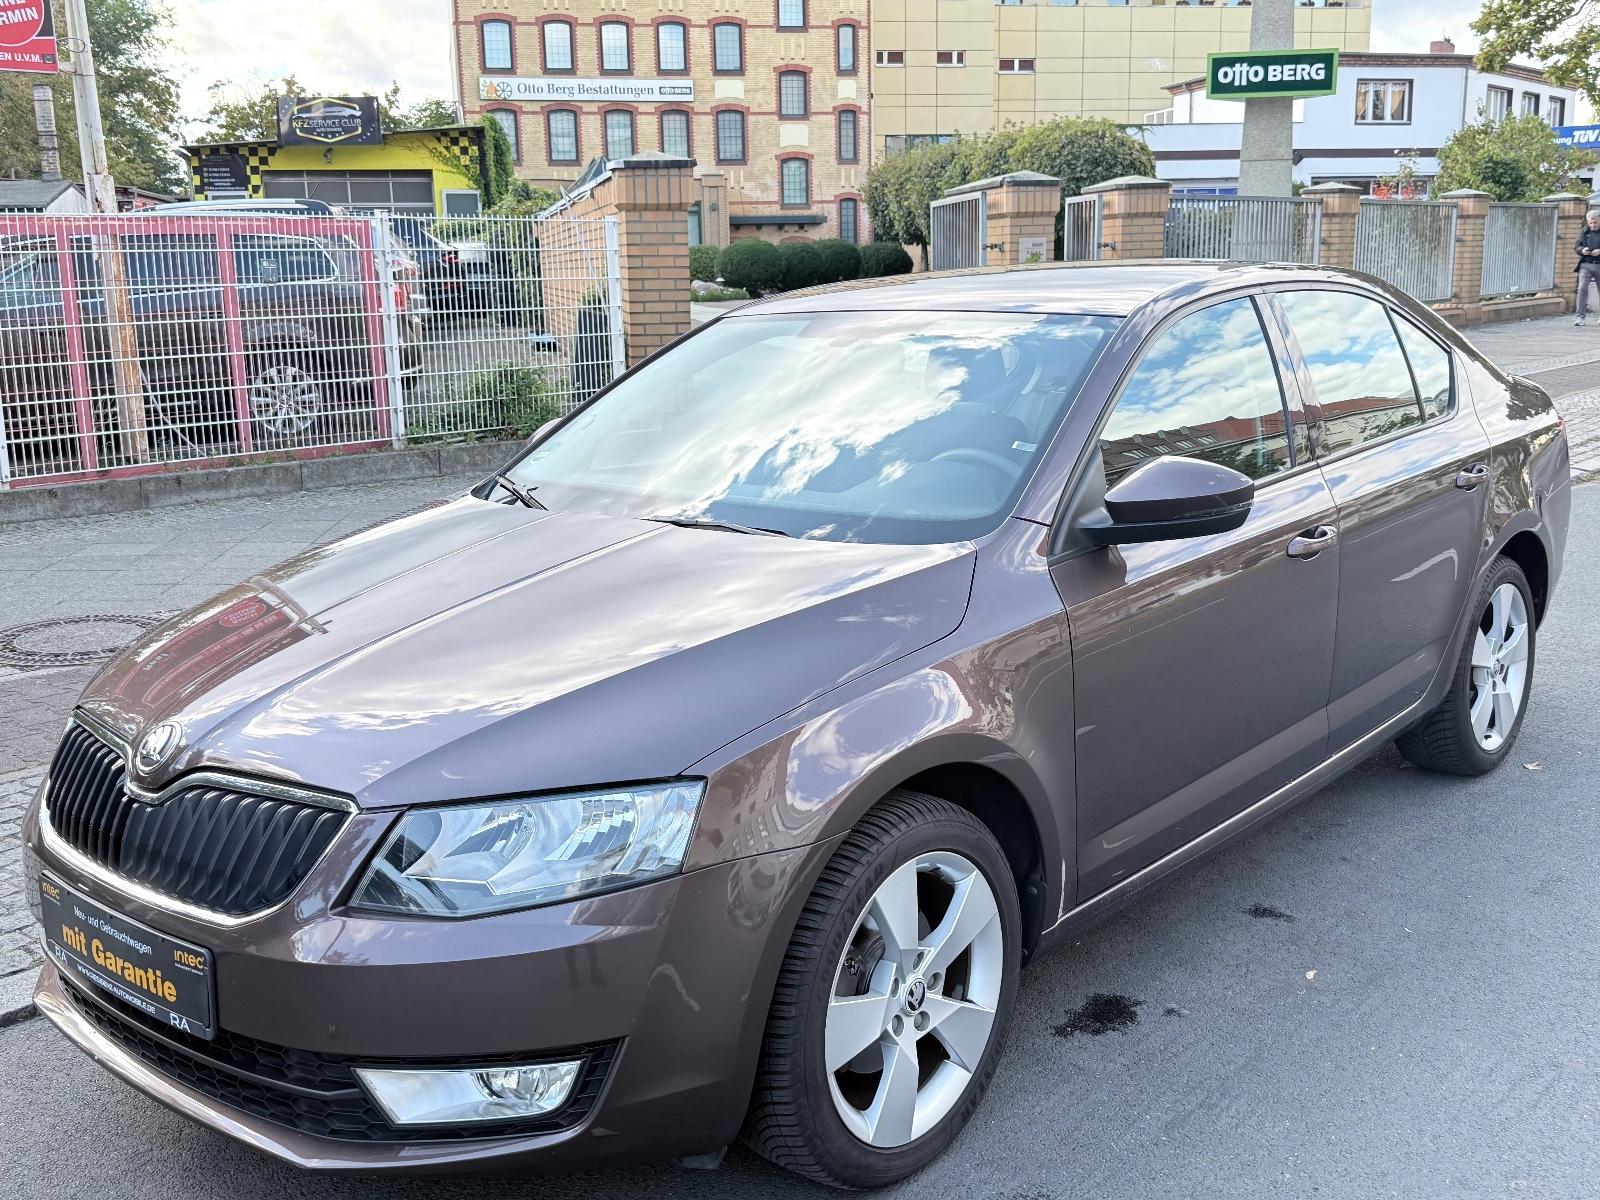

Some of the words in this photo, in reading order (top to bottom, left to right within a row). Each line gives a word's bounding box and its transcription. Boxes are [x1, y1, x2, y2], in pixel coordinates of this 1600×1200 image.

[1267, 63, 1325, 82] BERG
[517, 82, 543, 94] Otto
[547, 83, 574, 97] Berg
[577, 83, 654, 98] Bestattungen
[341, 118, 362, 127] CLUB
[1553, 137, 1572, 146] ung
[87, 915, 99, 928] und
[99, 919, 153, 955] Gebrauchtwagen
[54, 945, 68, 965] RA
[62, 923, 88, 957] mit
[91, 938, 178, 1004] Garantie
[169, 1012, 191, 1033] RA
